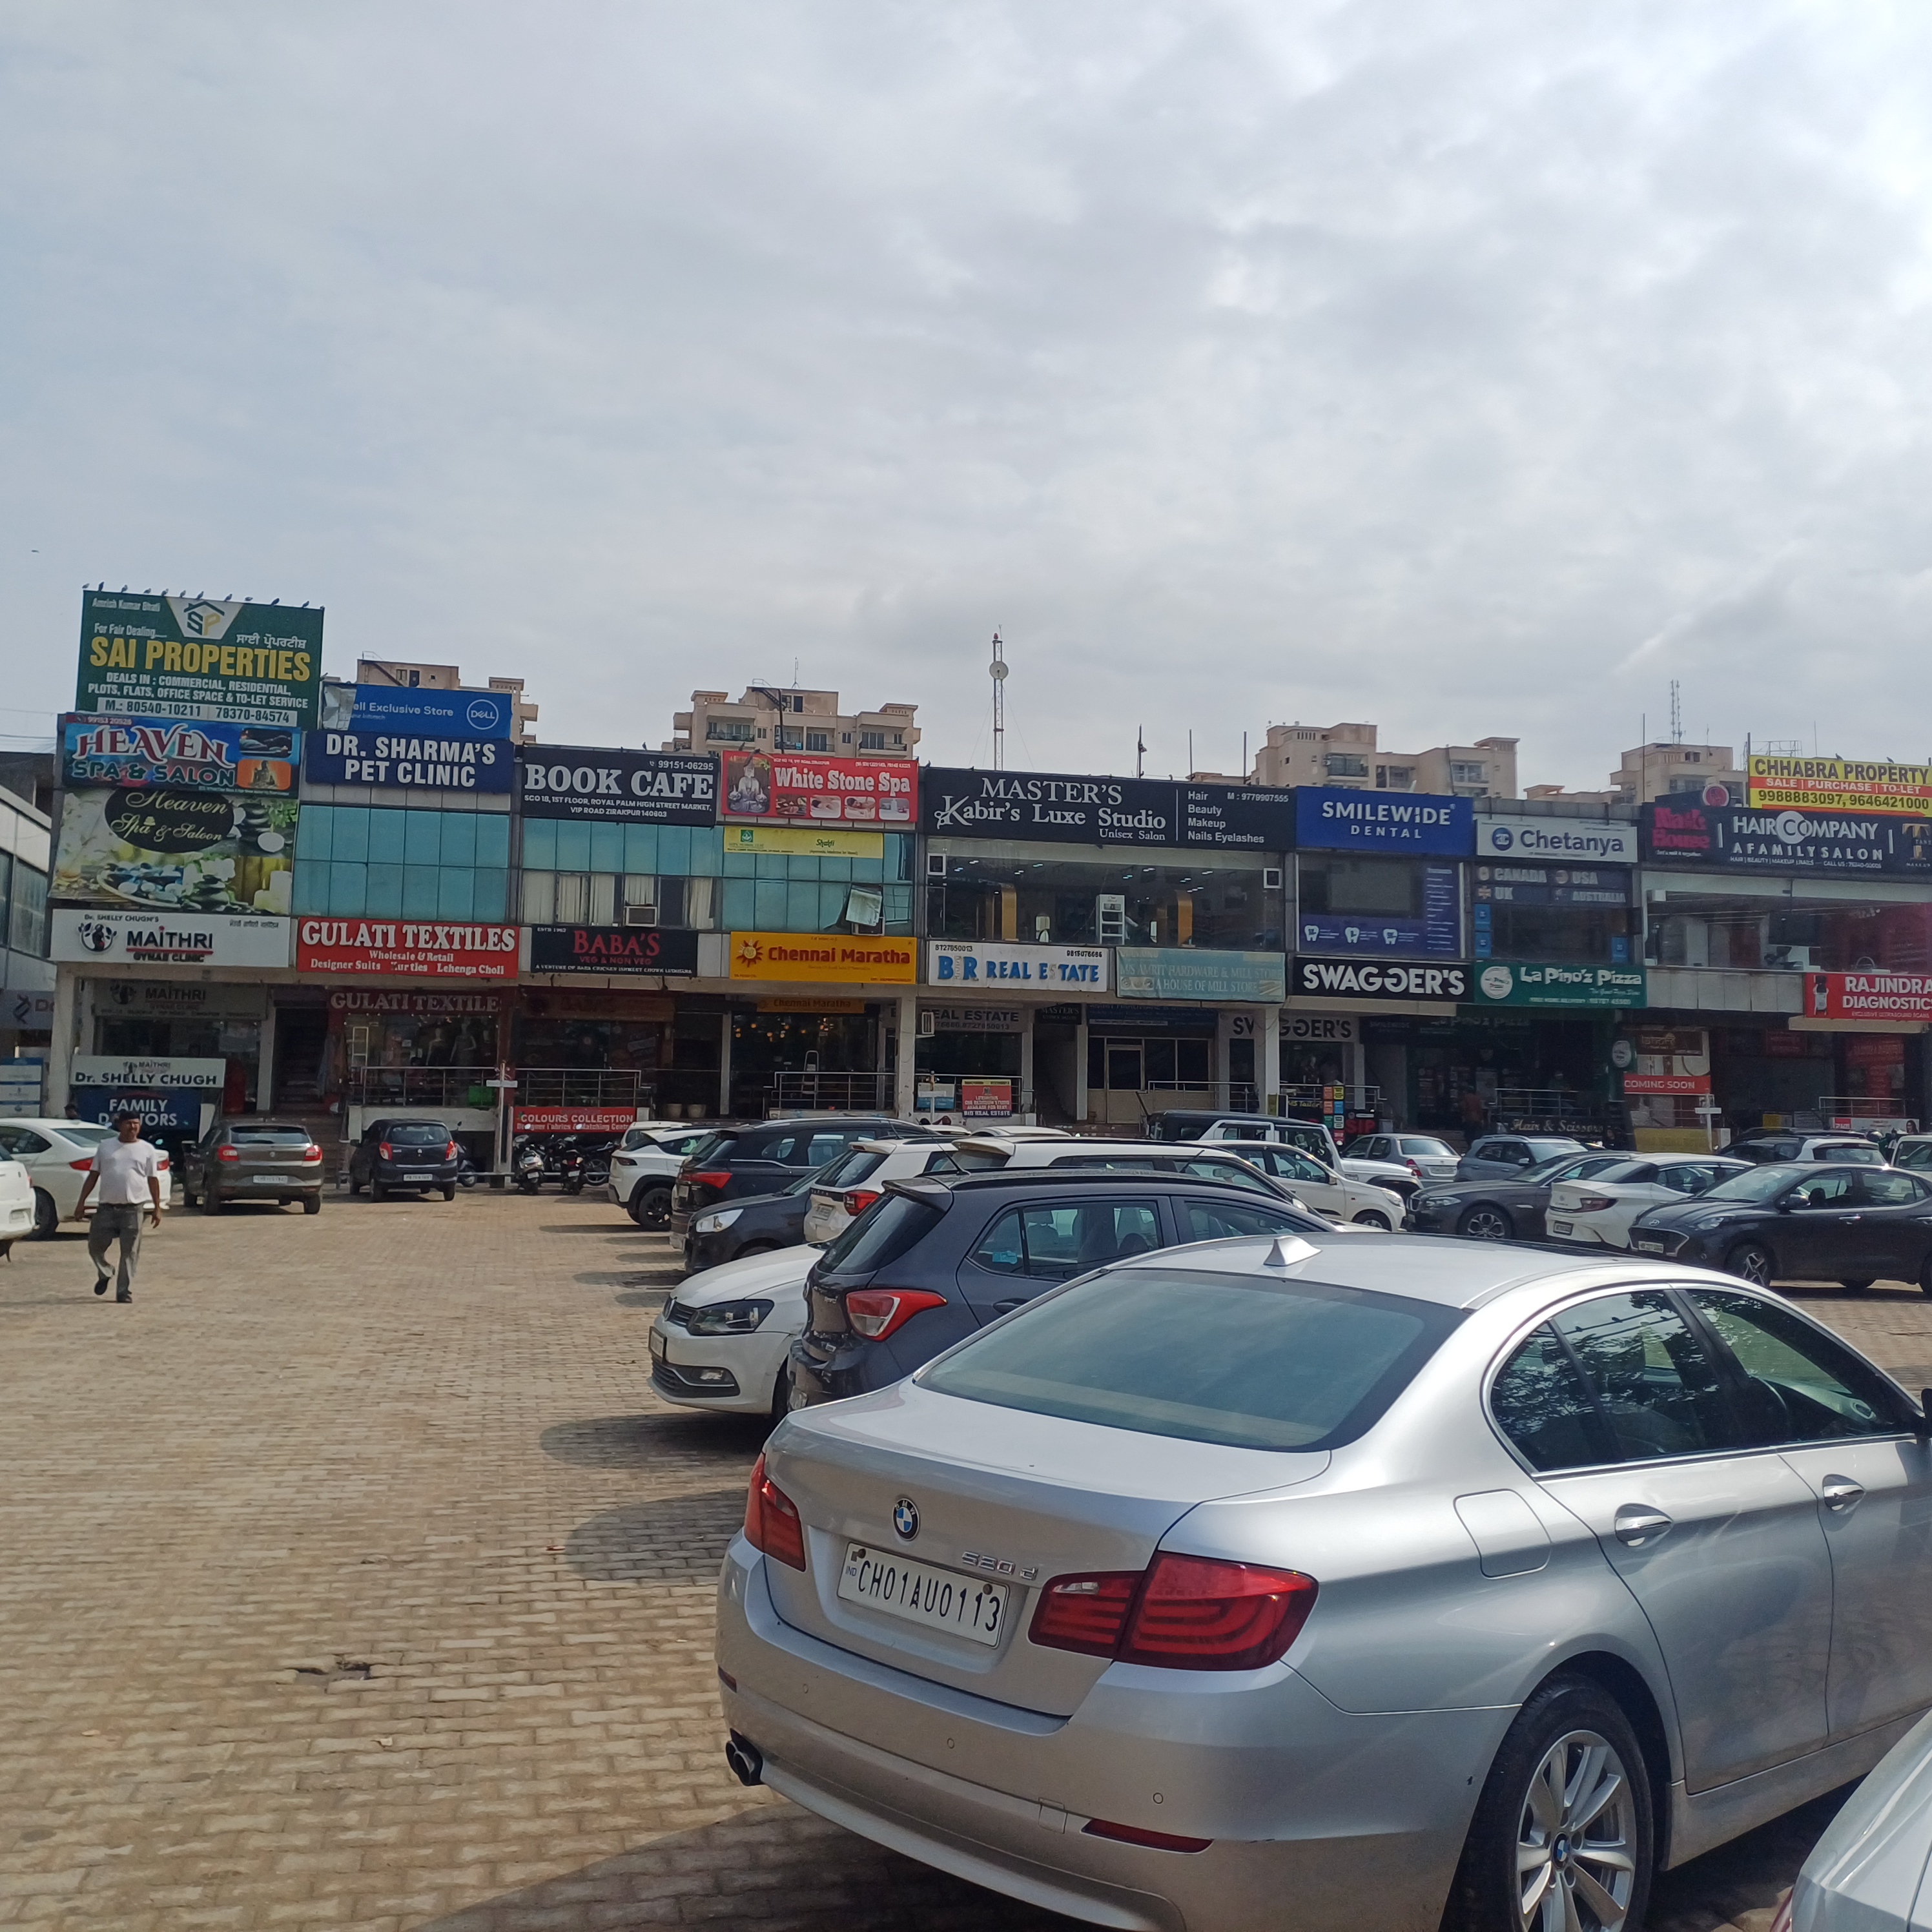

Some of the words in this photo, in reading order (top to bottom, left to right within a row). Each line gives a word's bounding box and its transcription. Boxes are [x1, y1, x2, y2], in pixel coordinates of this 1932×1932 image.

[94, 622, 108, 633] For
[109, 624, 125, 635] Fair
[90, 636, 136, 668] SAI
[145, 640, 311, 681] PROPERTIES
[107, 672, 137, 684] DEALS
[139, 674, 150, 684] IN
[159, 675, 226, 691] COMMERCIAL,
[229, 681, 291, 696] RESIDENTIAL,
[88, 683, 121, 695] PLOTS,
[123, 686, 154, 698] FLATS,
[158, 688, 190, 699] OFFICE
[192, 690, 223, 702] SPACE
[226, 692, 233, 703] &
[236, 694, 267, 705] TO-LET
[269, 697, 308, 708] SERVICE
[127, 702, 201, 717] 80540-10211
[216, 707, 289, 723] 78370-84574
[369, 703, 420, 714] Exclusive
[424, 706, 454, 716] Store
[471, 710, 495, 719] DELL
[72, 723, 236, 768] HEAVEN
[326, 734, 367, 757] DR.
[375, 736, 496, 765] SHARMA'S
[72, 761, 121, 779] SPA
[128, 763, 147, 779] &
[152, 765, 236, 787] SALON
[344, 759, 390, 782] PET
[397, 762, 475, 787] CLINIC
[657, 760, 714, 770] 99151-06295
[1754, 759, 1839, 779] CHHABRA
[1844, 763, 1929, 785] PROPERTY
[524, 764, 622, 794] BOOK
[630, 770, 714, 799] CAFE
[774, 766, 823, 789] White
[827, 770, 874, 792] Stone
[878, 772, 910, 797] Spa
[1766, 778, 1798, 788] SALE
[1808, 781, 1872, 792] PURCHASE
[1881, 784, 1921, 794] TO-LET
[980, 777, 1122, 805] MASTER'S
[1188, 791, 1208, 800] Hair
[1758, 790, 1846, 807] 9988883097,
[1849, 794, 1929, 810] 9646421000
[125, 790, 228, 816] Heaven
[1188, 804, 1222, 816] Beauty
[934, 796, 1020, 830] Kabir's
[1033, 804, 1086, 825] Luxe
[1098, 808, 1166, 829] Studio
[1322, 801, 1451, 825] SMILEWIDE
[110, 813, 150, 839] Spa
[154, 825, 170, 842] &
[173, 823, 223, 841] Saloon
[1188, 817, 1226, 830] Makeup
[1351, 825, 1422, 839] DENTAL
[1733, 816, 1777, 835] HAIR
[1099, 828, 1133, 839] Unisex
[1138, 831, 1166, 841] Salon
[1188, 830, 1212, 840] Nails
[1215, 832, 1264, 843] Eyelashes
[1520, 829, 1624, 857] Chetanya
[1732, 842, 1742, 853] A
[1747, 843, 1816, 858] FAMILY
[1821, 846, 1883, 861] SALON
[1494, 867, 1547, 883] CANADA
[1571, 872, 1598, 884] USA
[1494, 887, 1514, 900] UK
[1572, 891, 1626, 903] AUSTRALIA
[302, 921, 396, 948] GULATI
[402, 925, 515, 952] TEXTILES
[573, 930, 661, 956] BABA'S
[172, 953, 205, 963] CLINIC
[369, 950, 415, 961] Wholesale
[427, 952, 454, 962] Retail
[609, 956, 633, 965] NON
[768, 946, 836, 962] Chennai
[841, 949, 910, 964] Maratha
[311, 958, 353, 970] Designer
[355, 960, 381, 970] Suits
[437, 963, 477, 976] Lehenga
[478, 965, 504, 974] Choli
[986, 961, 1032, 980] REAL
[1169, 966, 1218, 978] HARDWARE
[1155, 978, 1162, 989] A
[1164, 978, 1193, 990] HOUSE
[1195, 980, 1205, 991] OF
[1208, 981, 1228, 992] MILL
[1230, 981, 1257, 992] STORE
[1303, 963, 1465, 996] SWAGGER'S
[1520, 967, 1542, 983] La
[1597, 969, 1642, 986] Pizza
[331, 992, 409, 1010] GULATI
[1842, 996, 1932, 1010] DIAGNOSTIC
[964, 1010, 1019, 1022] ESTATE
[101, 1073, 155, 1085] SHELLY
[159, 1074, 217, 1085] CHUGH
[1624, 1080, 1664, 1089] COMING
[1667, 1080, 1695, 1089] SOON
[108, 1099, 168, 1113] FAMILY
[99, 1113, 177, 1126] DTORS
[571, 1115, 633, 1123] COLLECTION
[845, 1566, 858, 1577] IND
[858, 1559, 1001, 1632] CH01AU0113
